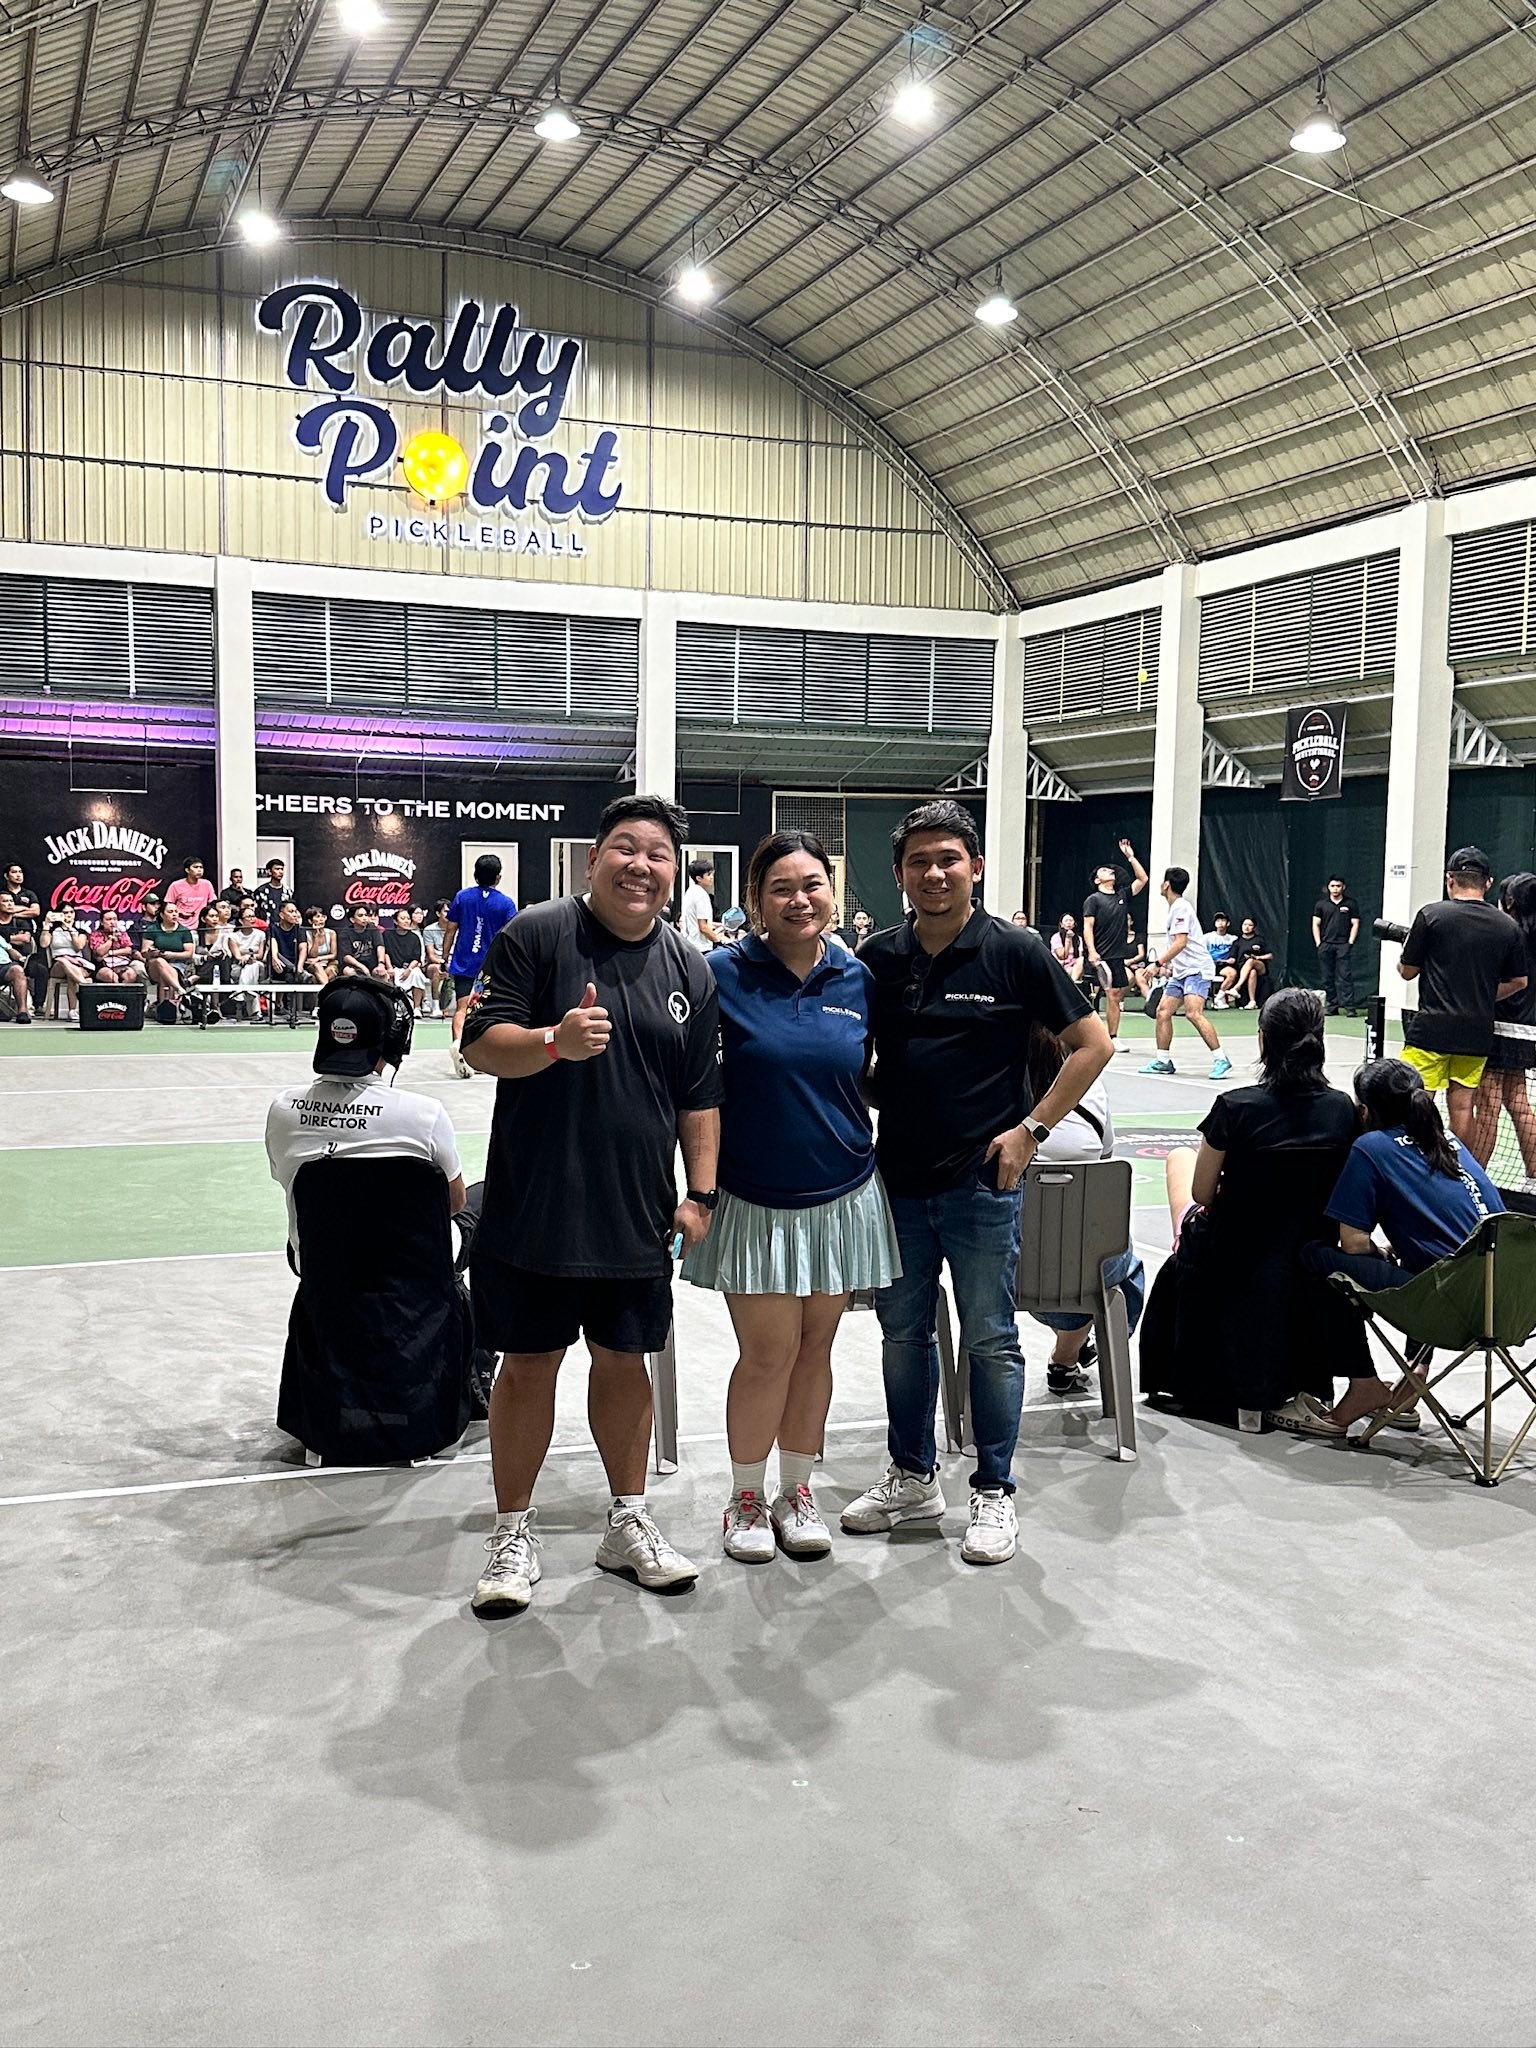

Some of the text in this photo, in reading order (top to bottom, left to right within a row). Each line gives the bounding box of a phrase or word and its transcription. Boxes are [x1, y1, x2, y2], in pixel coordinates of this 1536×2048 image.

[258, 283, 581, 438] Rally
[295, 395, 622, 516] Point
[369, 515, 584, 552] PICKLEBALL
[399, 799, 451, 818] THE
[456, 801, 565, 822] MOMENT
[44, 820, 168, 870] JACK DANIEL'S
[341, 852, 371, 877] JACK
[51, 876, 163, 913] Coca-Col
[345, 881, 415, 905] Coca-Cola
[290, 1098, 384, 1117] TOURNAMENT
[299, 1113, 368, 1130] DIRECTOR
[1264, 1411, 1300, 1429] crocs
